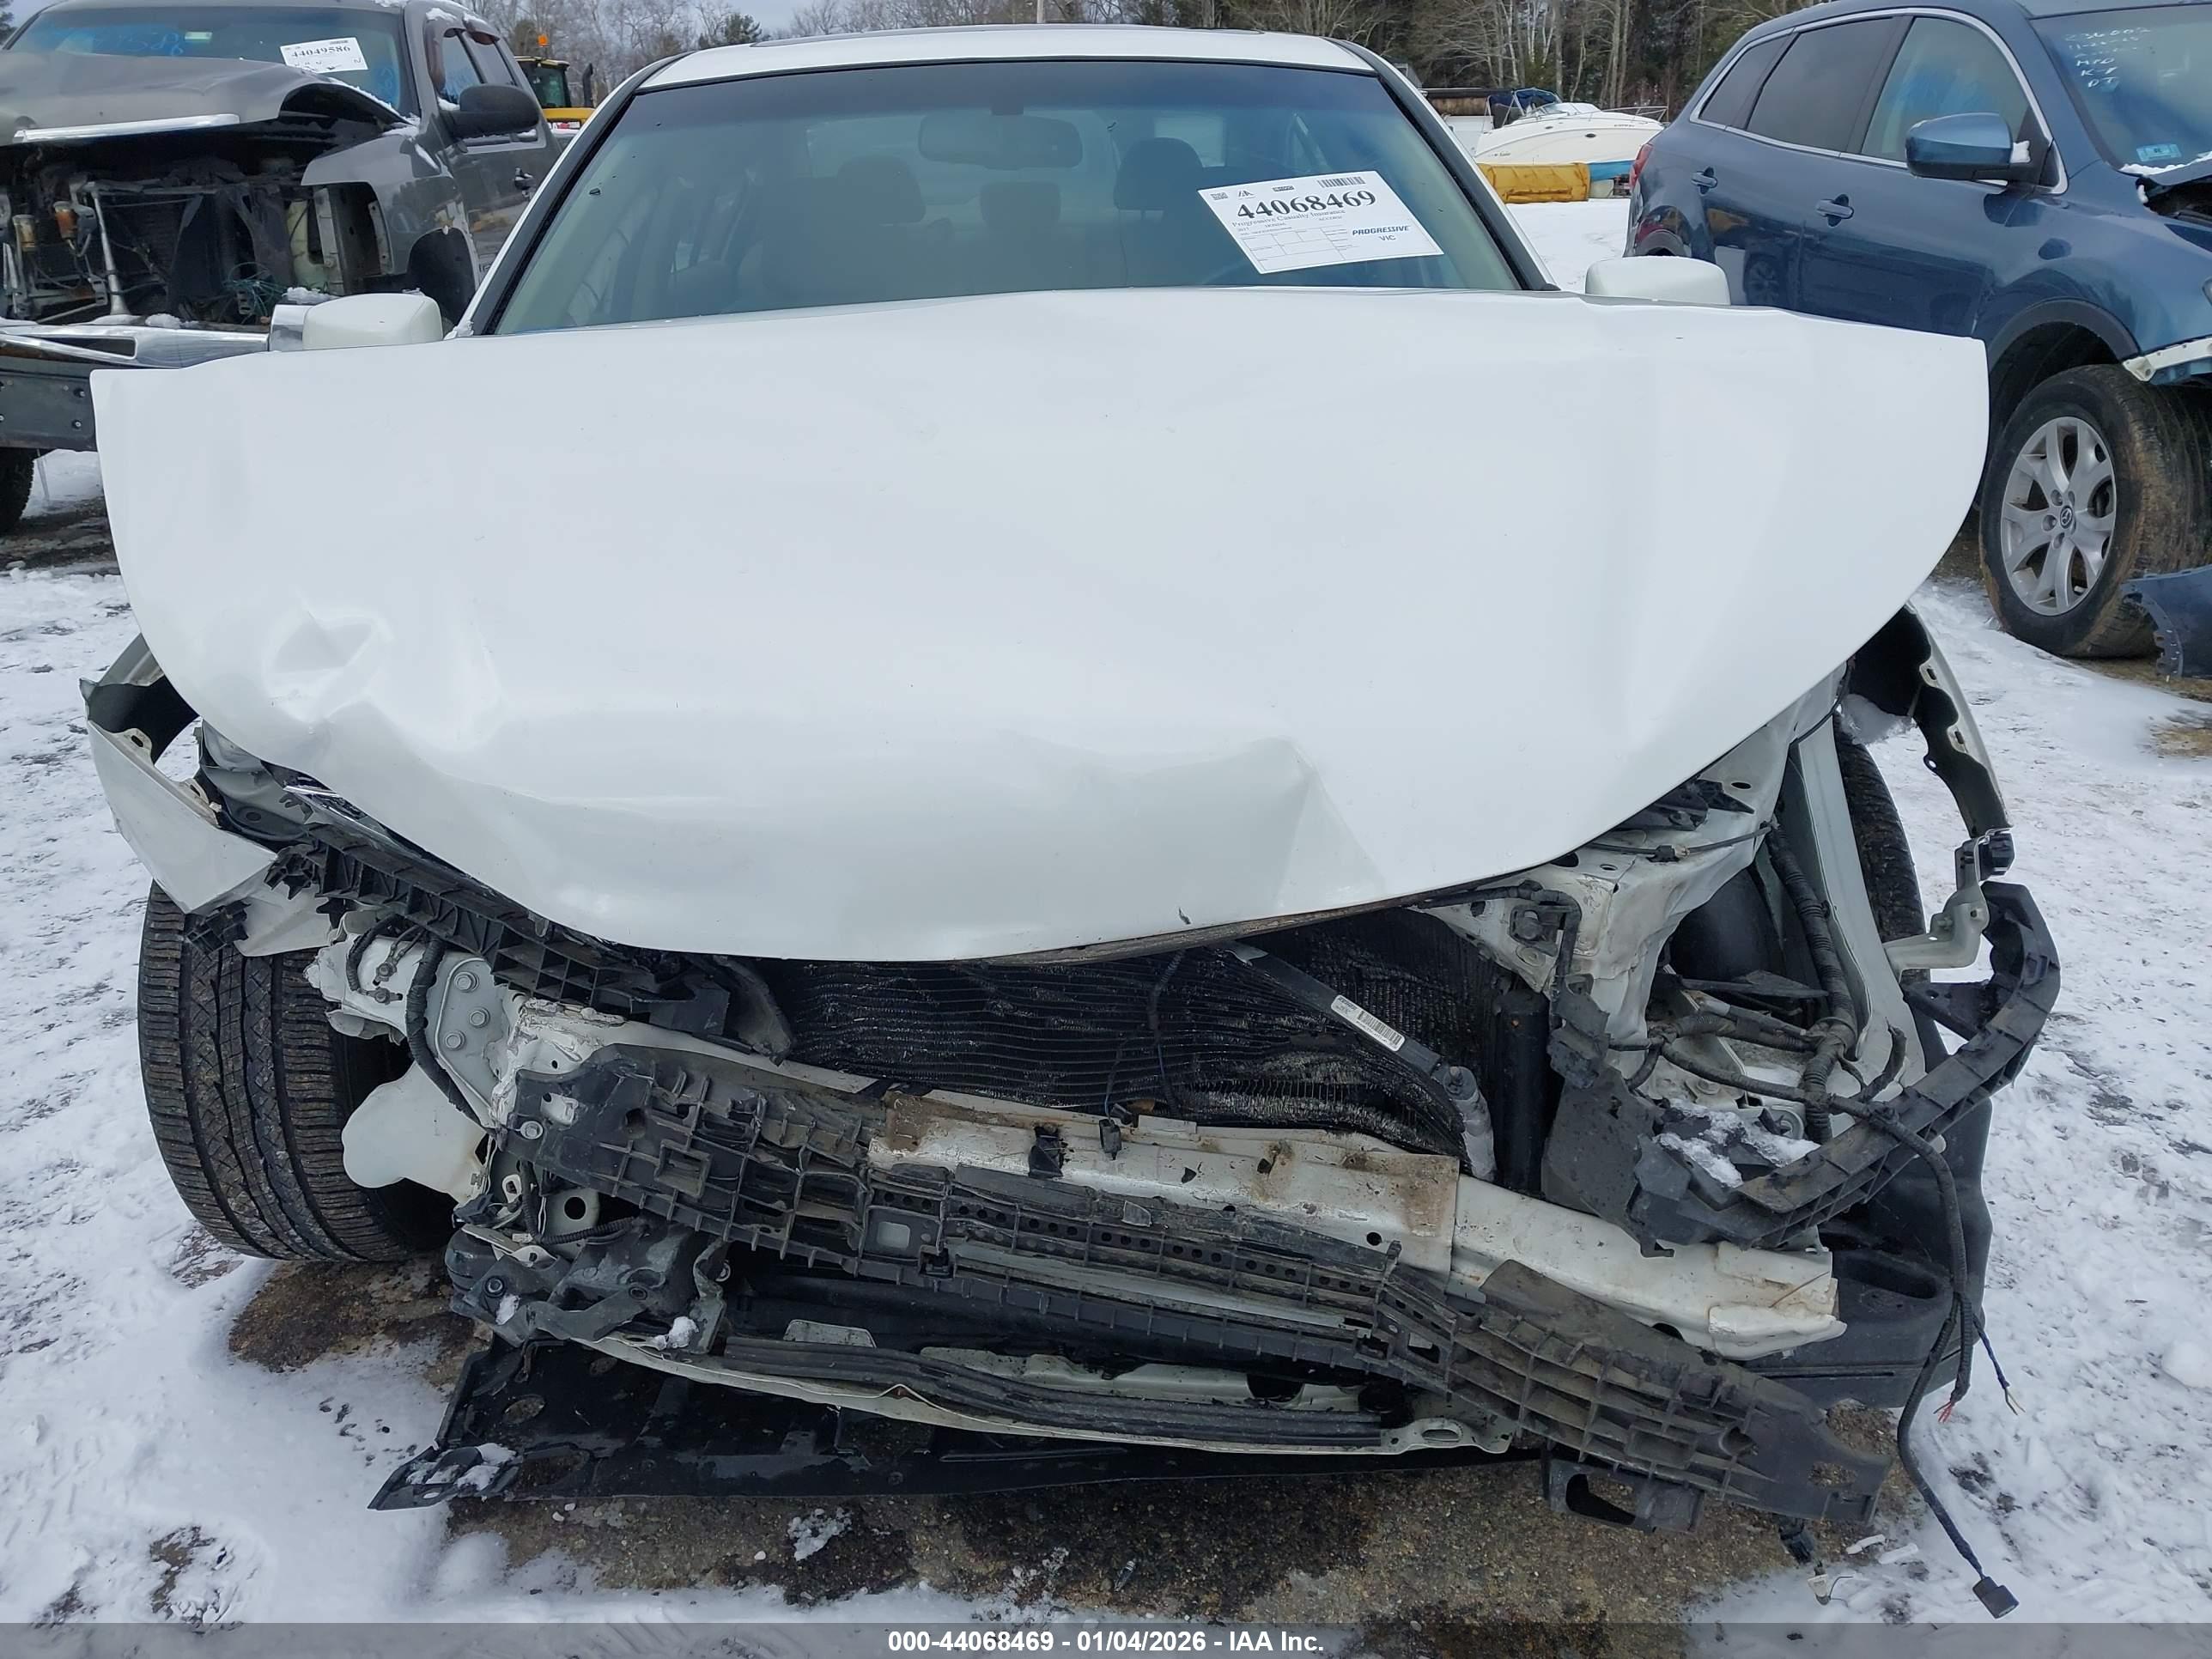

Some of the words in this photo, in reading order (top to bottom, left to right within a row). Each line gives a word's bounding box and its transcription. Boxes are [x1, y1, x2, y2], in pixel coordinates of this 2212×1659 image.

[292, 46, 350, 58] 44049586
[1237, 190, 1376, 219] 44068469
[1231, 216, 1276, 228] Progressive
[1277, 212, 1309, 222] Casualty
[1310, 209, 1346, 218] Insurance
[1352, 225, 1410, 236] PROGRESSIVE
